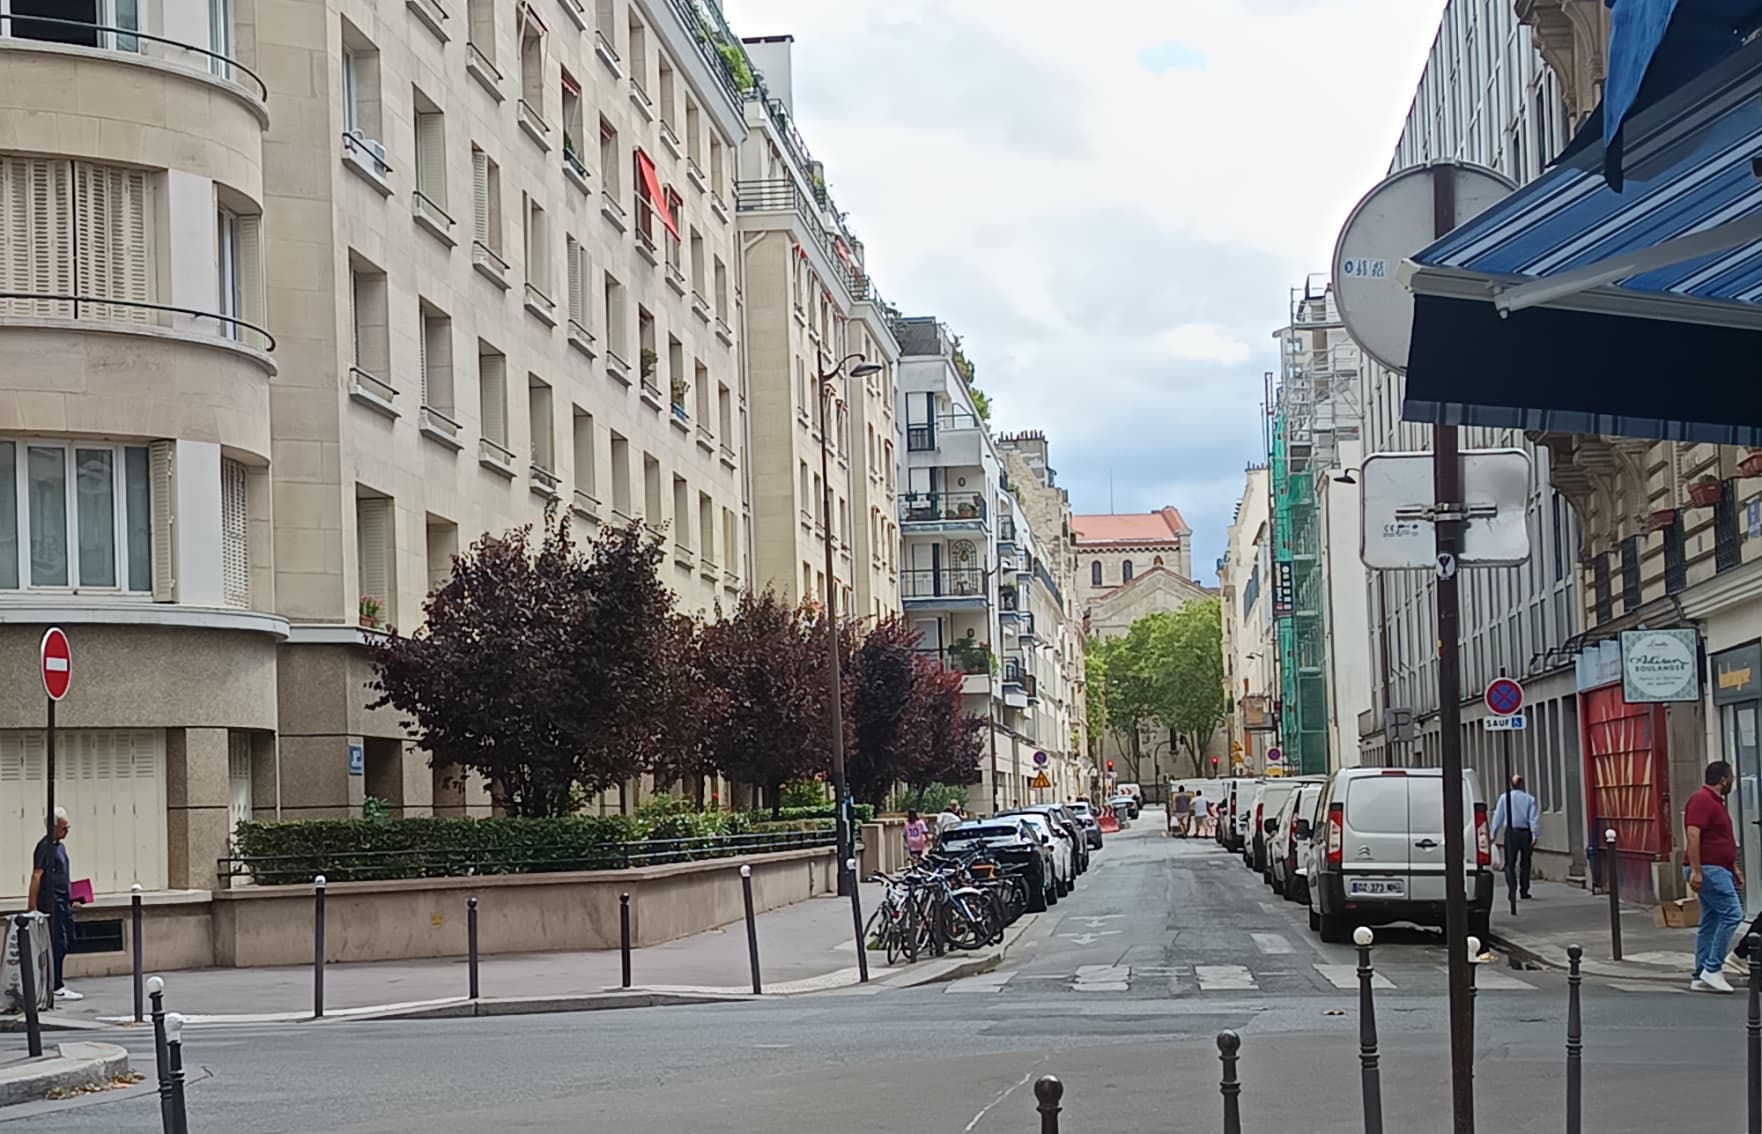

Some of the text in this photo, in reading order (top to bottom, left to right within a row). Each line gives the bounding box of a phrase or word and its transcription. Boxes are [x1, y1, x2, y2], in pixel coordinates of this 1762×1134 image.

[1635, 664, 1685, 672] BOULANGER
[1486, 719, 1510, 728] SAUF
[908, 827, 919, 837] 10
